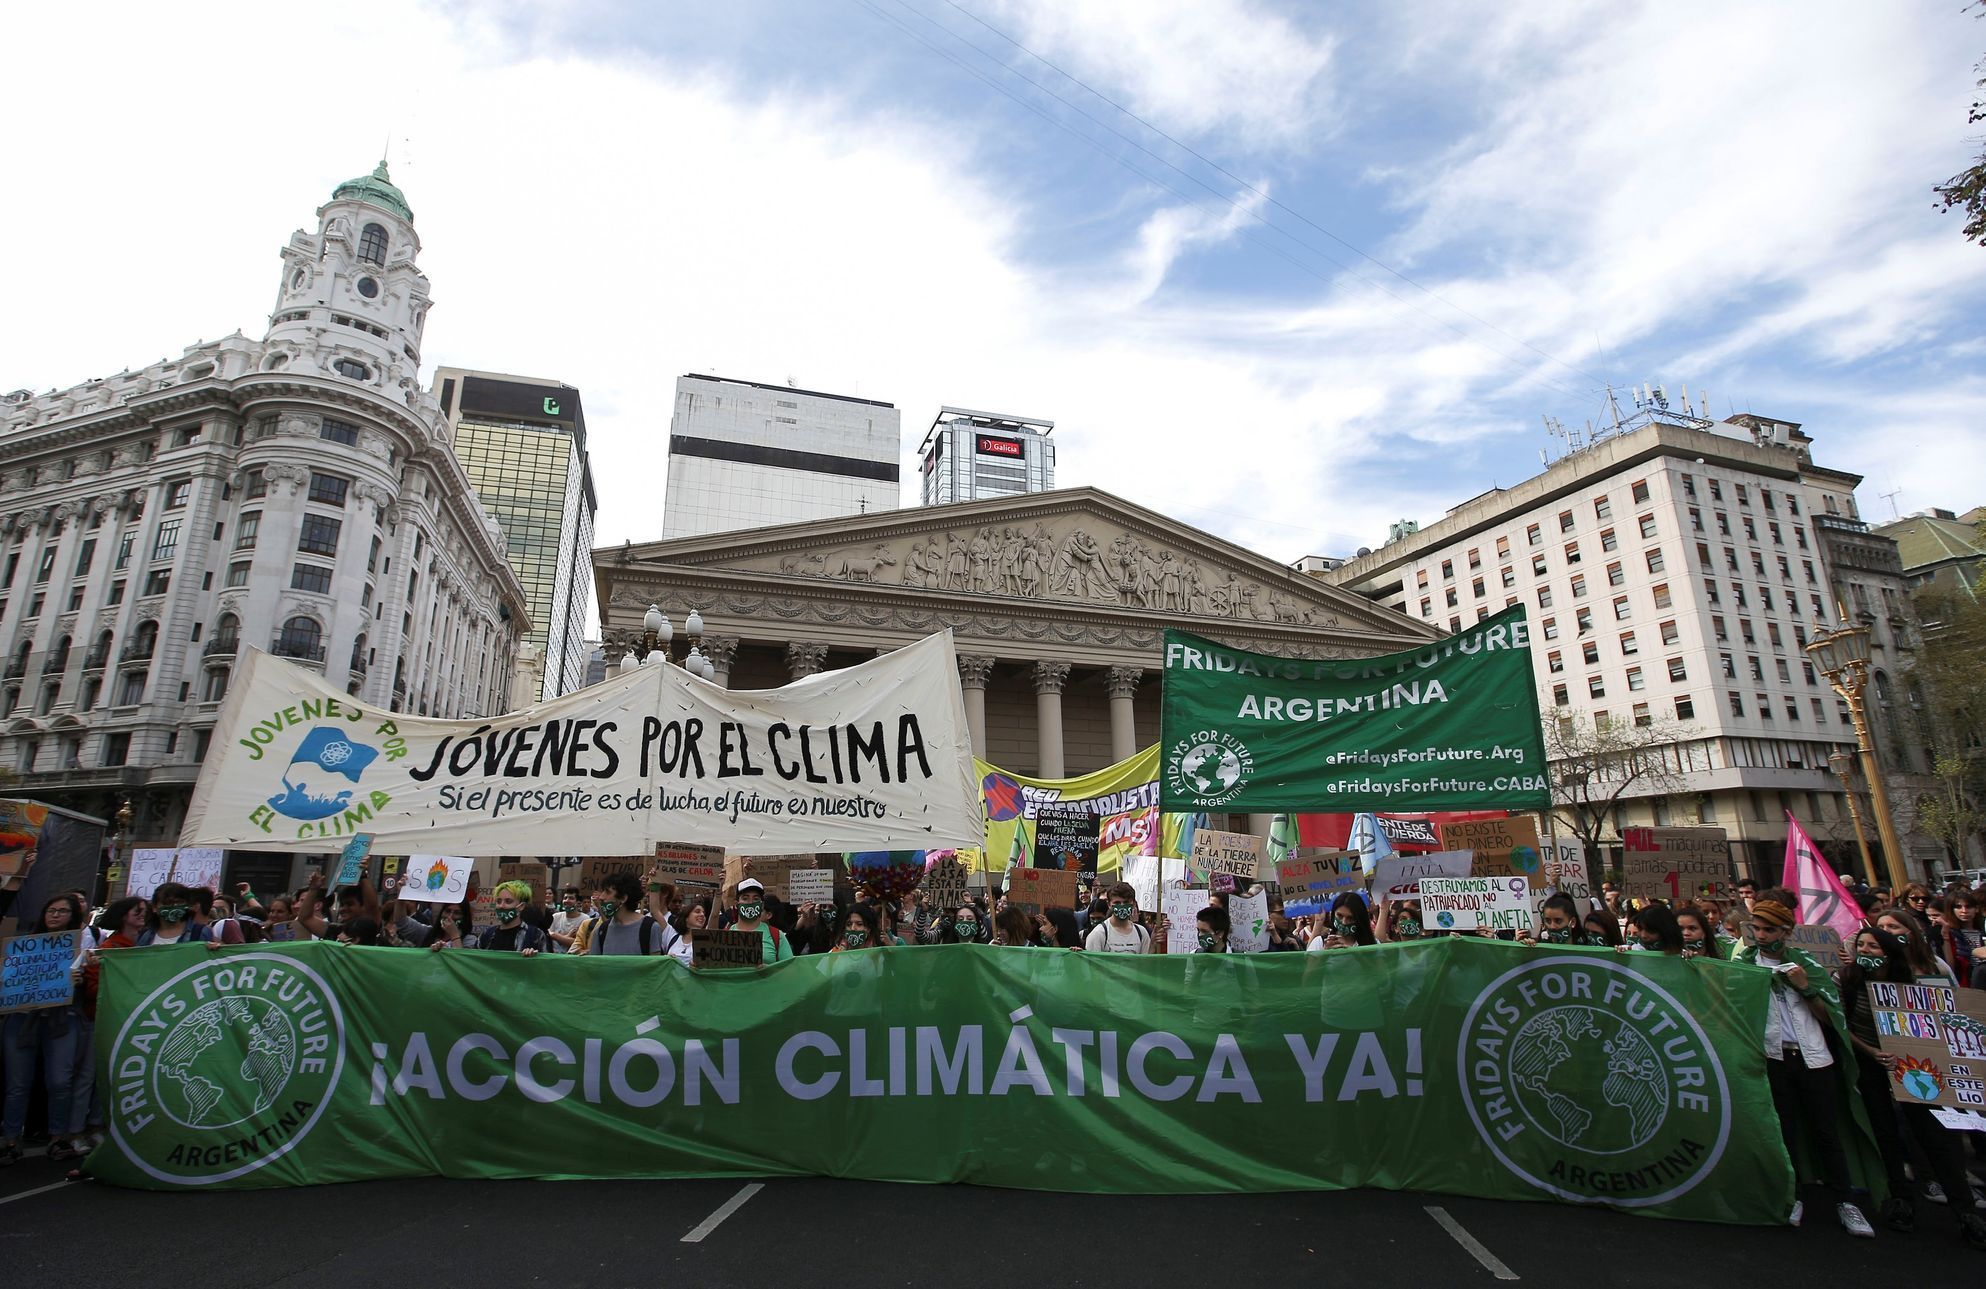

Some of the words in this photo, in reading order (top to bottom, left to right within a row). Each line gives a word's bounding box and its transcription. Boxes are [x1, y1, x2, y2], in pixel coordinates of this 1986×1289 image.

[993, 443, 1018, 454] Galicia
[1164, 643, 1304, 680] FRIDAYS
[1396, 621, 1530, 672] FUTURE
[1237, 679, 1448, 723] ARGENTINA
[239, 697, 364, 761] JOVENES
[375, 719, 408, 763] POR
[409, 718, 620, 782] JÓVENES
[638, 715, 706, 779] POR
[717, 721, 764, 779] EL
[767, 713, 933, 785] CLIMA
[1167, 740, 1190, 796] FRIDAYS
[1190, 730, 1218, 745] FOR
[1221, 733, 1254, 774] FUTURE
[1021, 785, 1062, 804] RED
[1192, 779, 1249, 807] ARGENTINA
[439, 784, 465, 811] Si
[466, 786, 491, 812] el
[492, 787, 592, 819] presente
[597, 793, 622, 811] es
[625, 787, 653, 811] de
[714, 791, 729, 811] el
[729, 791, 784, 824] futuro
[788, 798, 810, 816] es
[811, 794, 888, 819] nuestro
[247, 804, 275, 834] EL
[296, 790, 393, 839] CLIMA
[1069, 813, 1090, 821] HACER
[1445, 825, 1463, 837] NO
[1465, 821, 1507, 836] EXISTE
[1199, 833, 1212, 846] LA
[1466, 835, 1514, 849] DINERO
[1194, 846, 1205, 856] DE
[1208, 849, 1219, 858] LA
[1222, 848, 1258, 863] TIERRA
[1559, 845, 1579, 862] DE
[592, 861, 644, 880] FUTURO
[688, 867, 713, 877] CALOR
[942, 859, 955, 869] LA
[1197, 857, 1223, 872] NUNCA
[1224, 860, 1255, 876] MUERE
[1281, 863, 1312, 879] ALZA
[1313, 860, 1329, 873] TU
[930, 869, 964, 879] CASA
[1023, 869, 1040, 881] NO
[929, 880, 951, 890] ESTA
[956, 880, 966, 890] EN
[1284, 886, 1295, 896] NO
[1297, 885, 1306, 893] EL
[1421, 879, 1488, 894] DESTRUYAMOS
[1492, 878, 1506, 892] AL
[1664, 872, 1680, 899] 1
[1170, 892, 1180, 901] LA
[1483, 893, 1497, 902] NO
[13, 938, 37, 955] NO
[11, 962, 59, 978] JUSTICIA
[24, 980, 39, 991] ES
[37, 988, 70, 1002] SOCIAL
[1872, 983, 1899, 1008] LOS
[1904, 985, 1955, 1013] UNICOS
[1875, 1011, 1937, 1039] HEROES
[118, 993, 186, 1134] FRIDAYS
[192, 966, 258, 1000] FOR
[262, 968, 329, 1074] FUTURE
[368, 1014, 742, 1109] ¡ACCIÓN
[775, 1004, 1263, 1102] CLIMÁTICA
[1283, 1027, 1424, 1103] YA!
[1474, 997, 1526, 1141] FRIDAYS
[1517, 971, 1593, 1008] FOR
[1603, 979, 1709, 1113] FUTURE
[1951, 1065, 1969, 1076] EN
[1948, 1078, 1984, 1090] ESTE
[166, 1098, 314, 1168] ARGENTINA
[1548, 1137, 1705, 1192] ARGENTINA
